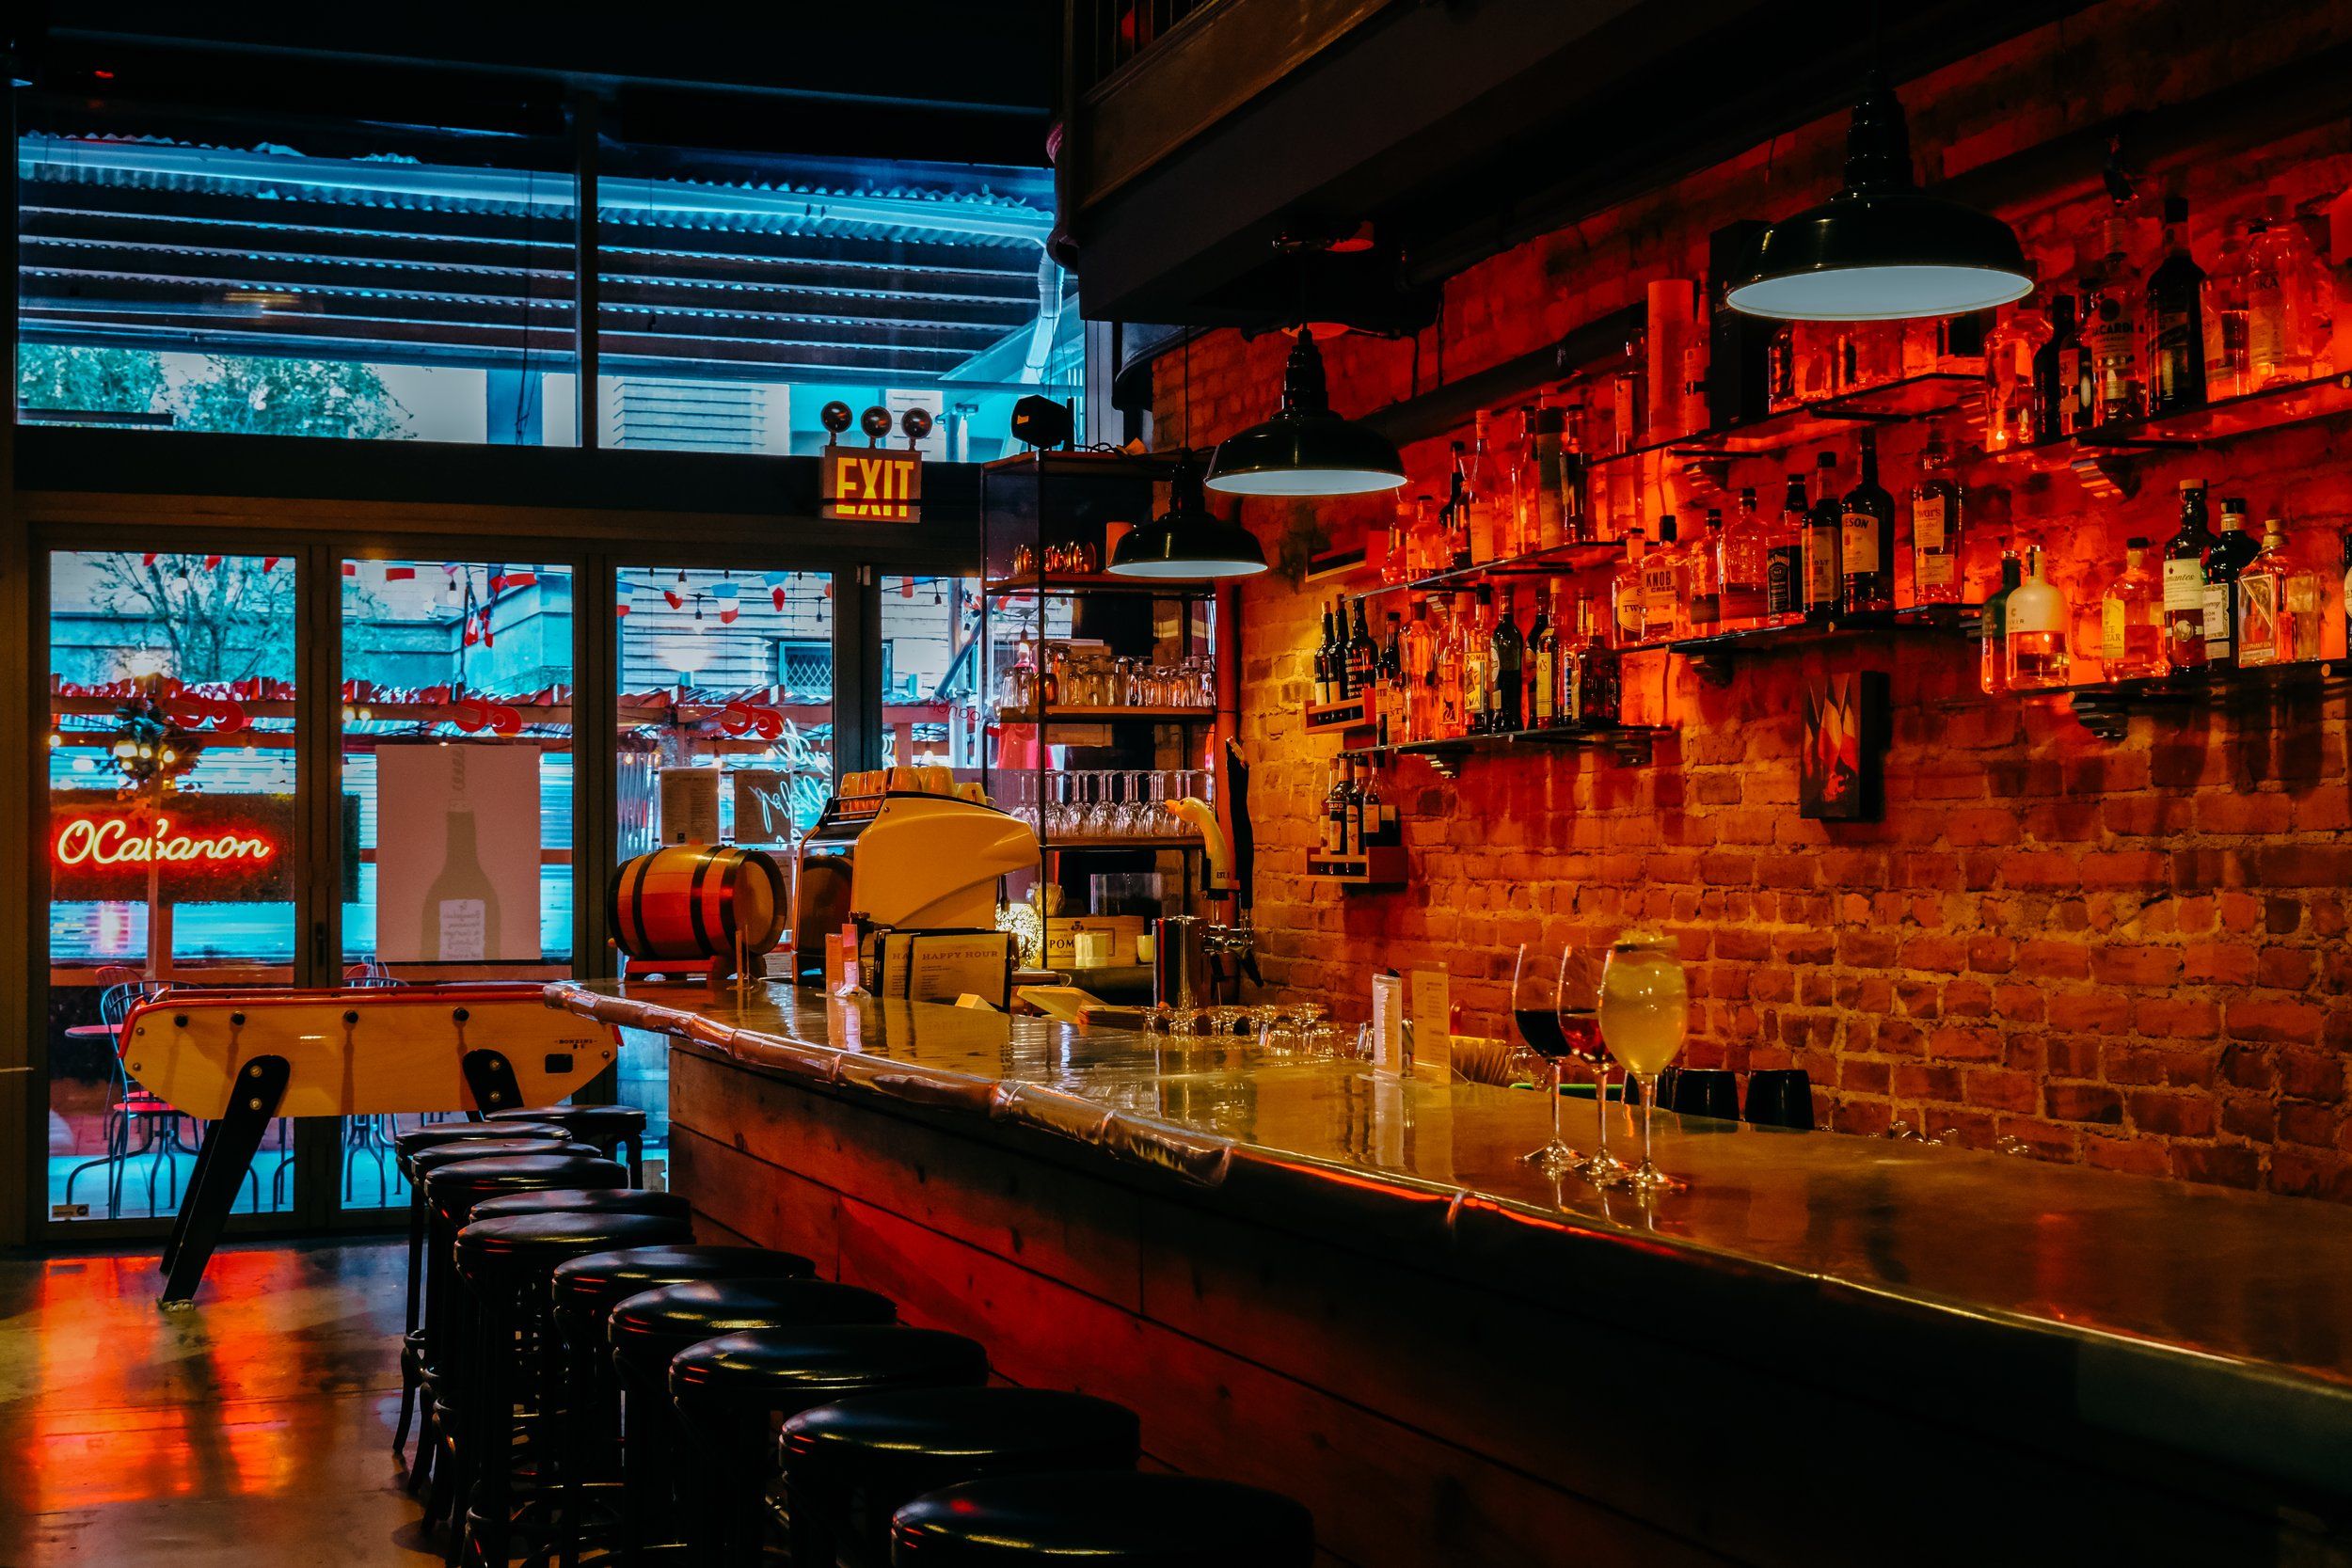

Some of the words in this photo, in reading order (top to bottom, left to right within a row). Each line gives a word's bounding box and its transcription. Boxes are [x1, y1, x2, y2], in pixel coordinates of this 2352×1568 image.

[835, 457, 914, 517] EXIT
[1645, 570, 1672, 588] KNOB
[1650, 585, 1677, 594] CREEK
[1049, 939, 1074, 949] POM
[921, 952, 961, 961] HAPPY
[965, 950, 999, 958] HOUR
